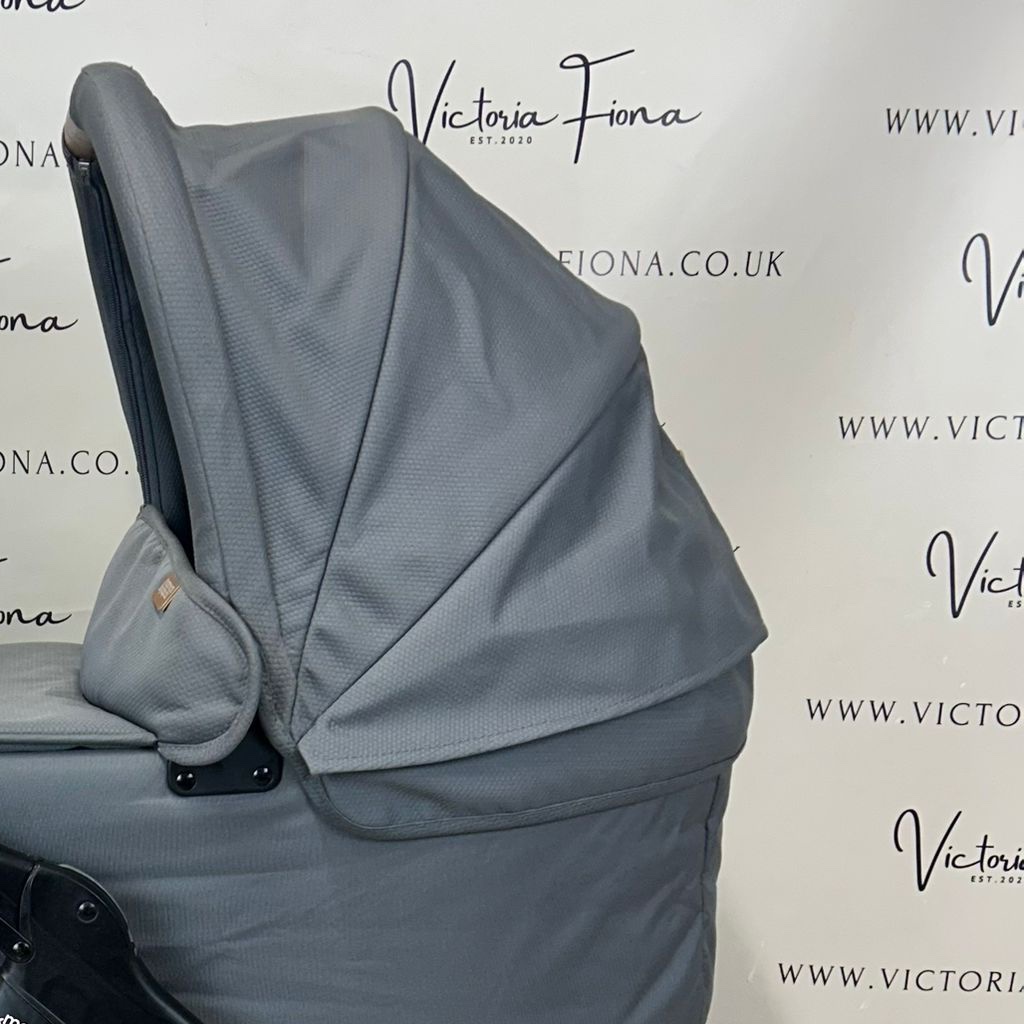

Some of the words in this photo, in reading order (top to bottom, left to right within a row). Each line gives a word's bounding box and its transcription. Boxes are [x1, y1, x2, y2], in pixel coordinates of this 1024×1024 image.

[387, 59, 559, 145] Victoria
[559, 49, 702, 164] Fiona
[470, 136, 533, 144] EST.2020
[894, 808, 1024, 892] Victori
[778, 963, 1024, 993] WWW.VICTORI
